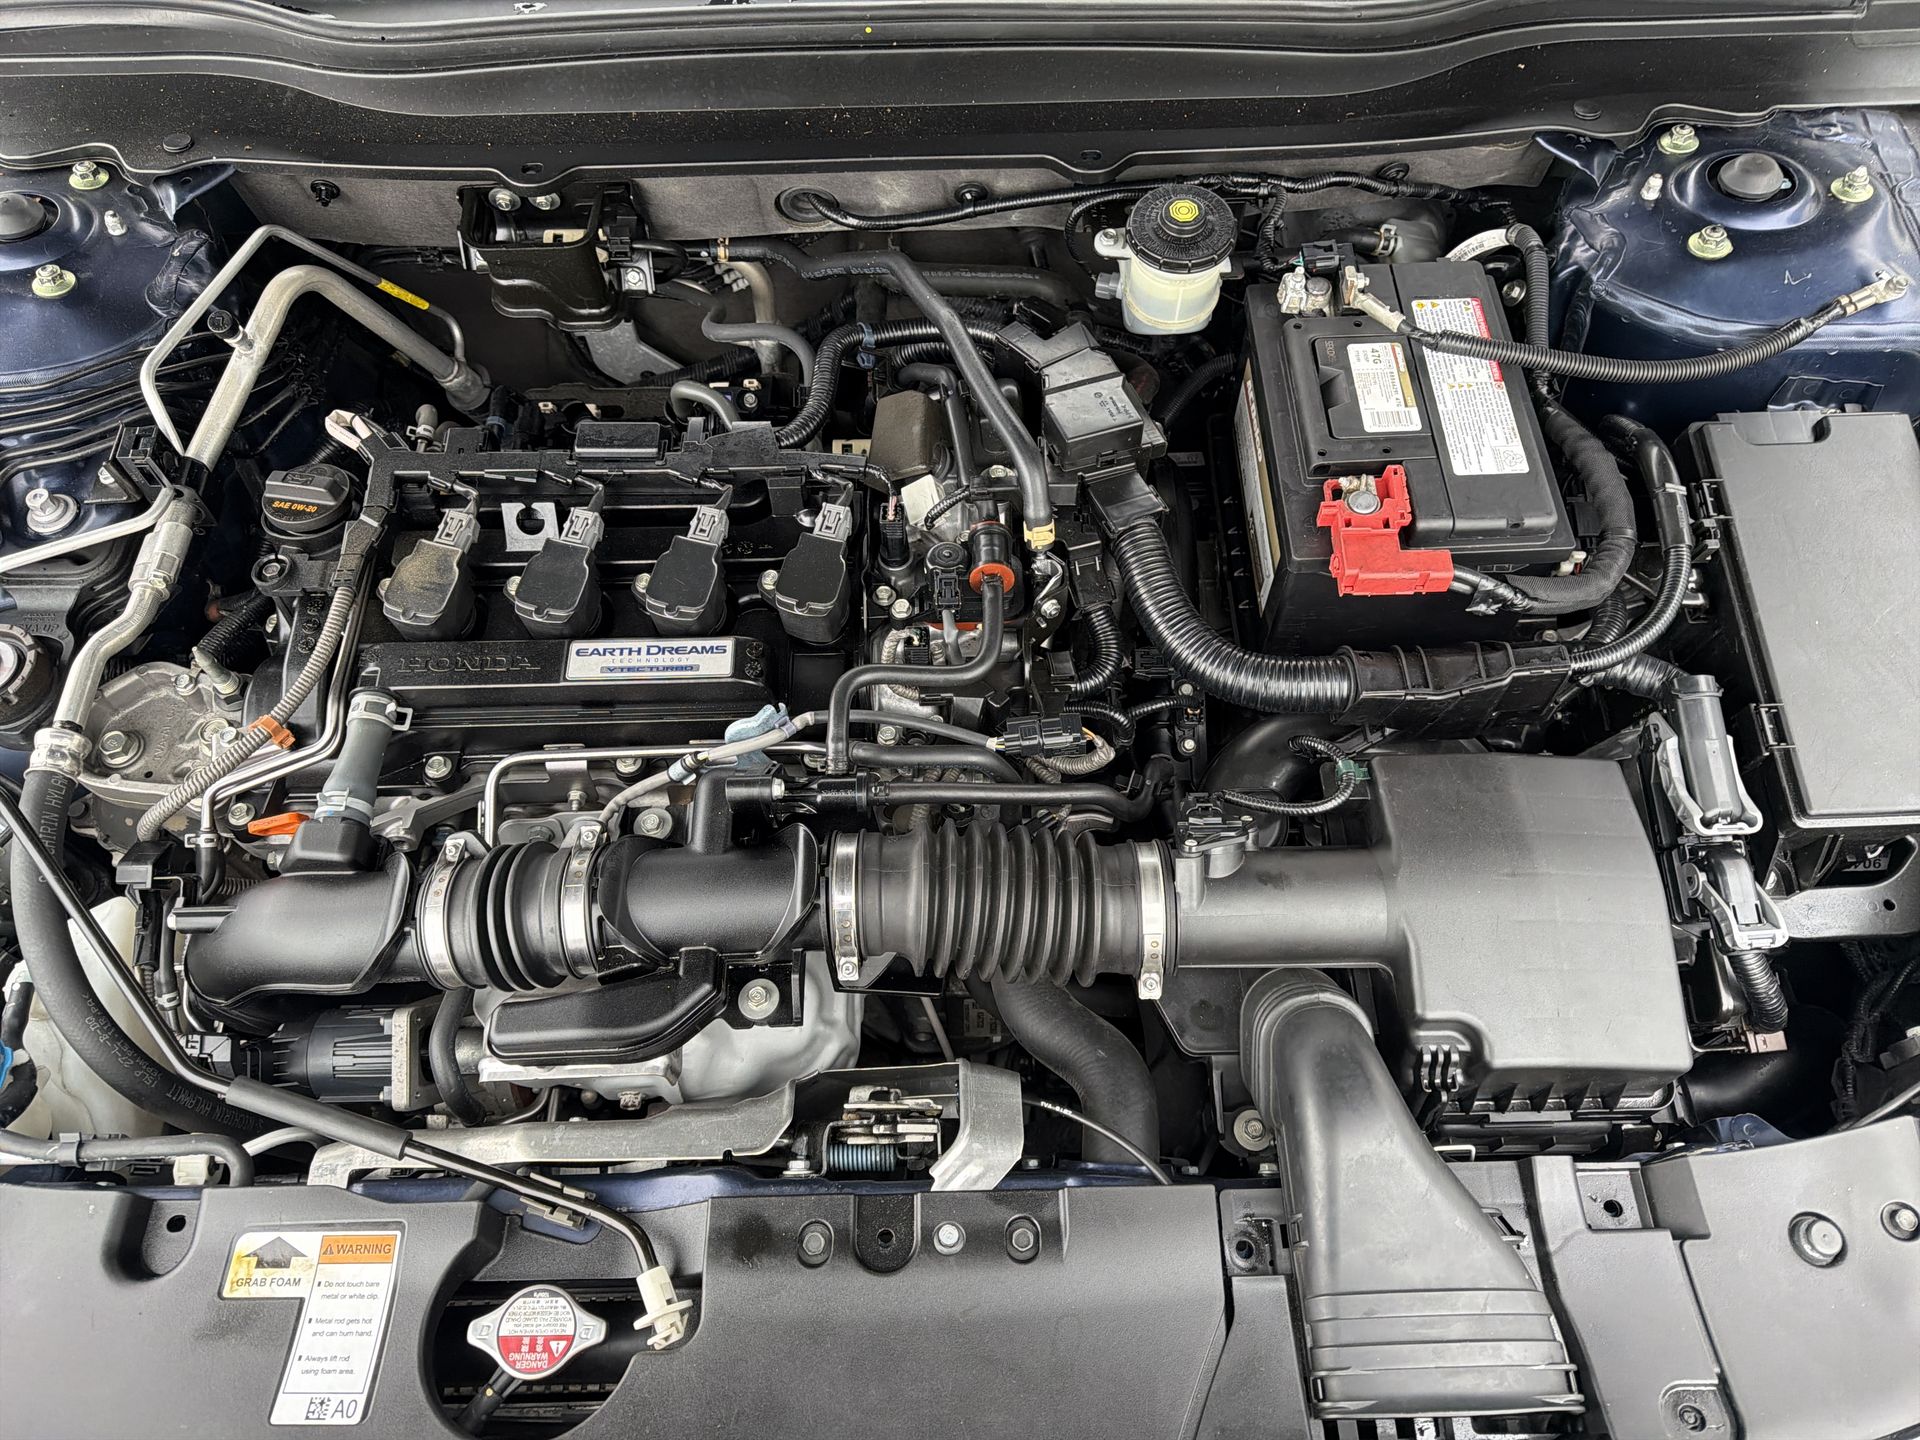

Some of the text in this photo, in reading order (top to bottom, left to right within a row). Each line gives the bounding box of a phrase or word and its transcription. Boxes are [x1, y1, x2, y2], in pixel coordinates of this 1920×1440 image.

[1370, 347, 1382, 365] 47G
[272, 500, 318, 513] SAE 0W-20
[575, 645, 727, 657] EARTH DREAMS
[396, 654, 541, 673] HONDA
[336, 1243, 391, 1255] WARNING
[236, 1277, 301, 1287] GRAB FOAM
[324, 1280, 334, 1288] Do
[346, 1280, 363, 1288] touch
[365, 1280, 380, 1288] bare
[346, 1318, 360, 1326] gets
[304, 1355, 328, 1363] Always
[509, 1352, 548, 1361] WARNUNG
[301, 1368, 318, 1376] using
[332, 1399, 358, 1418] A0
